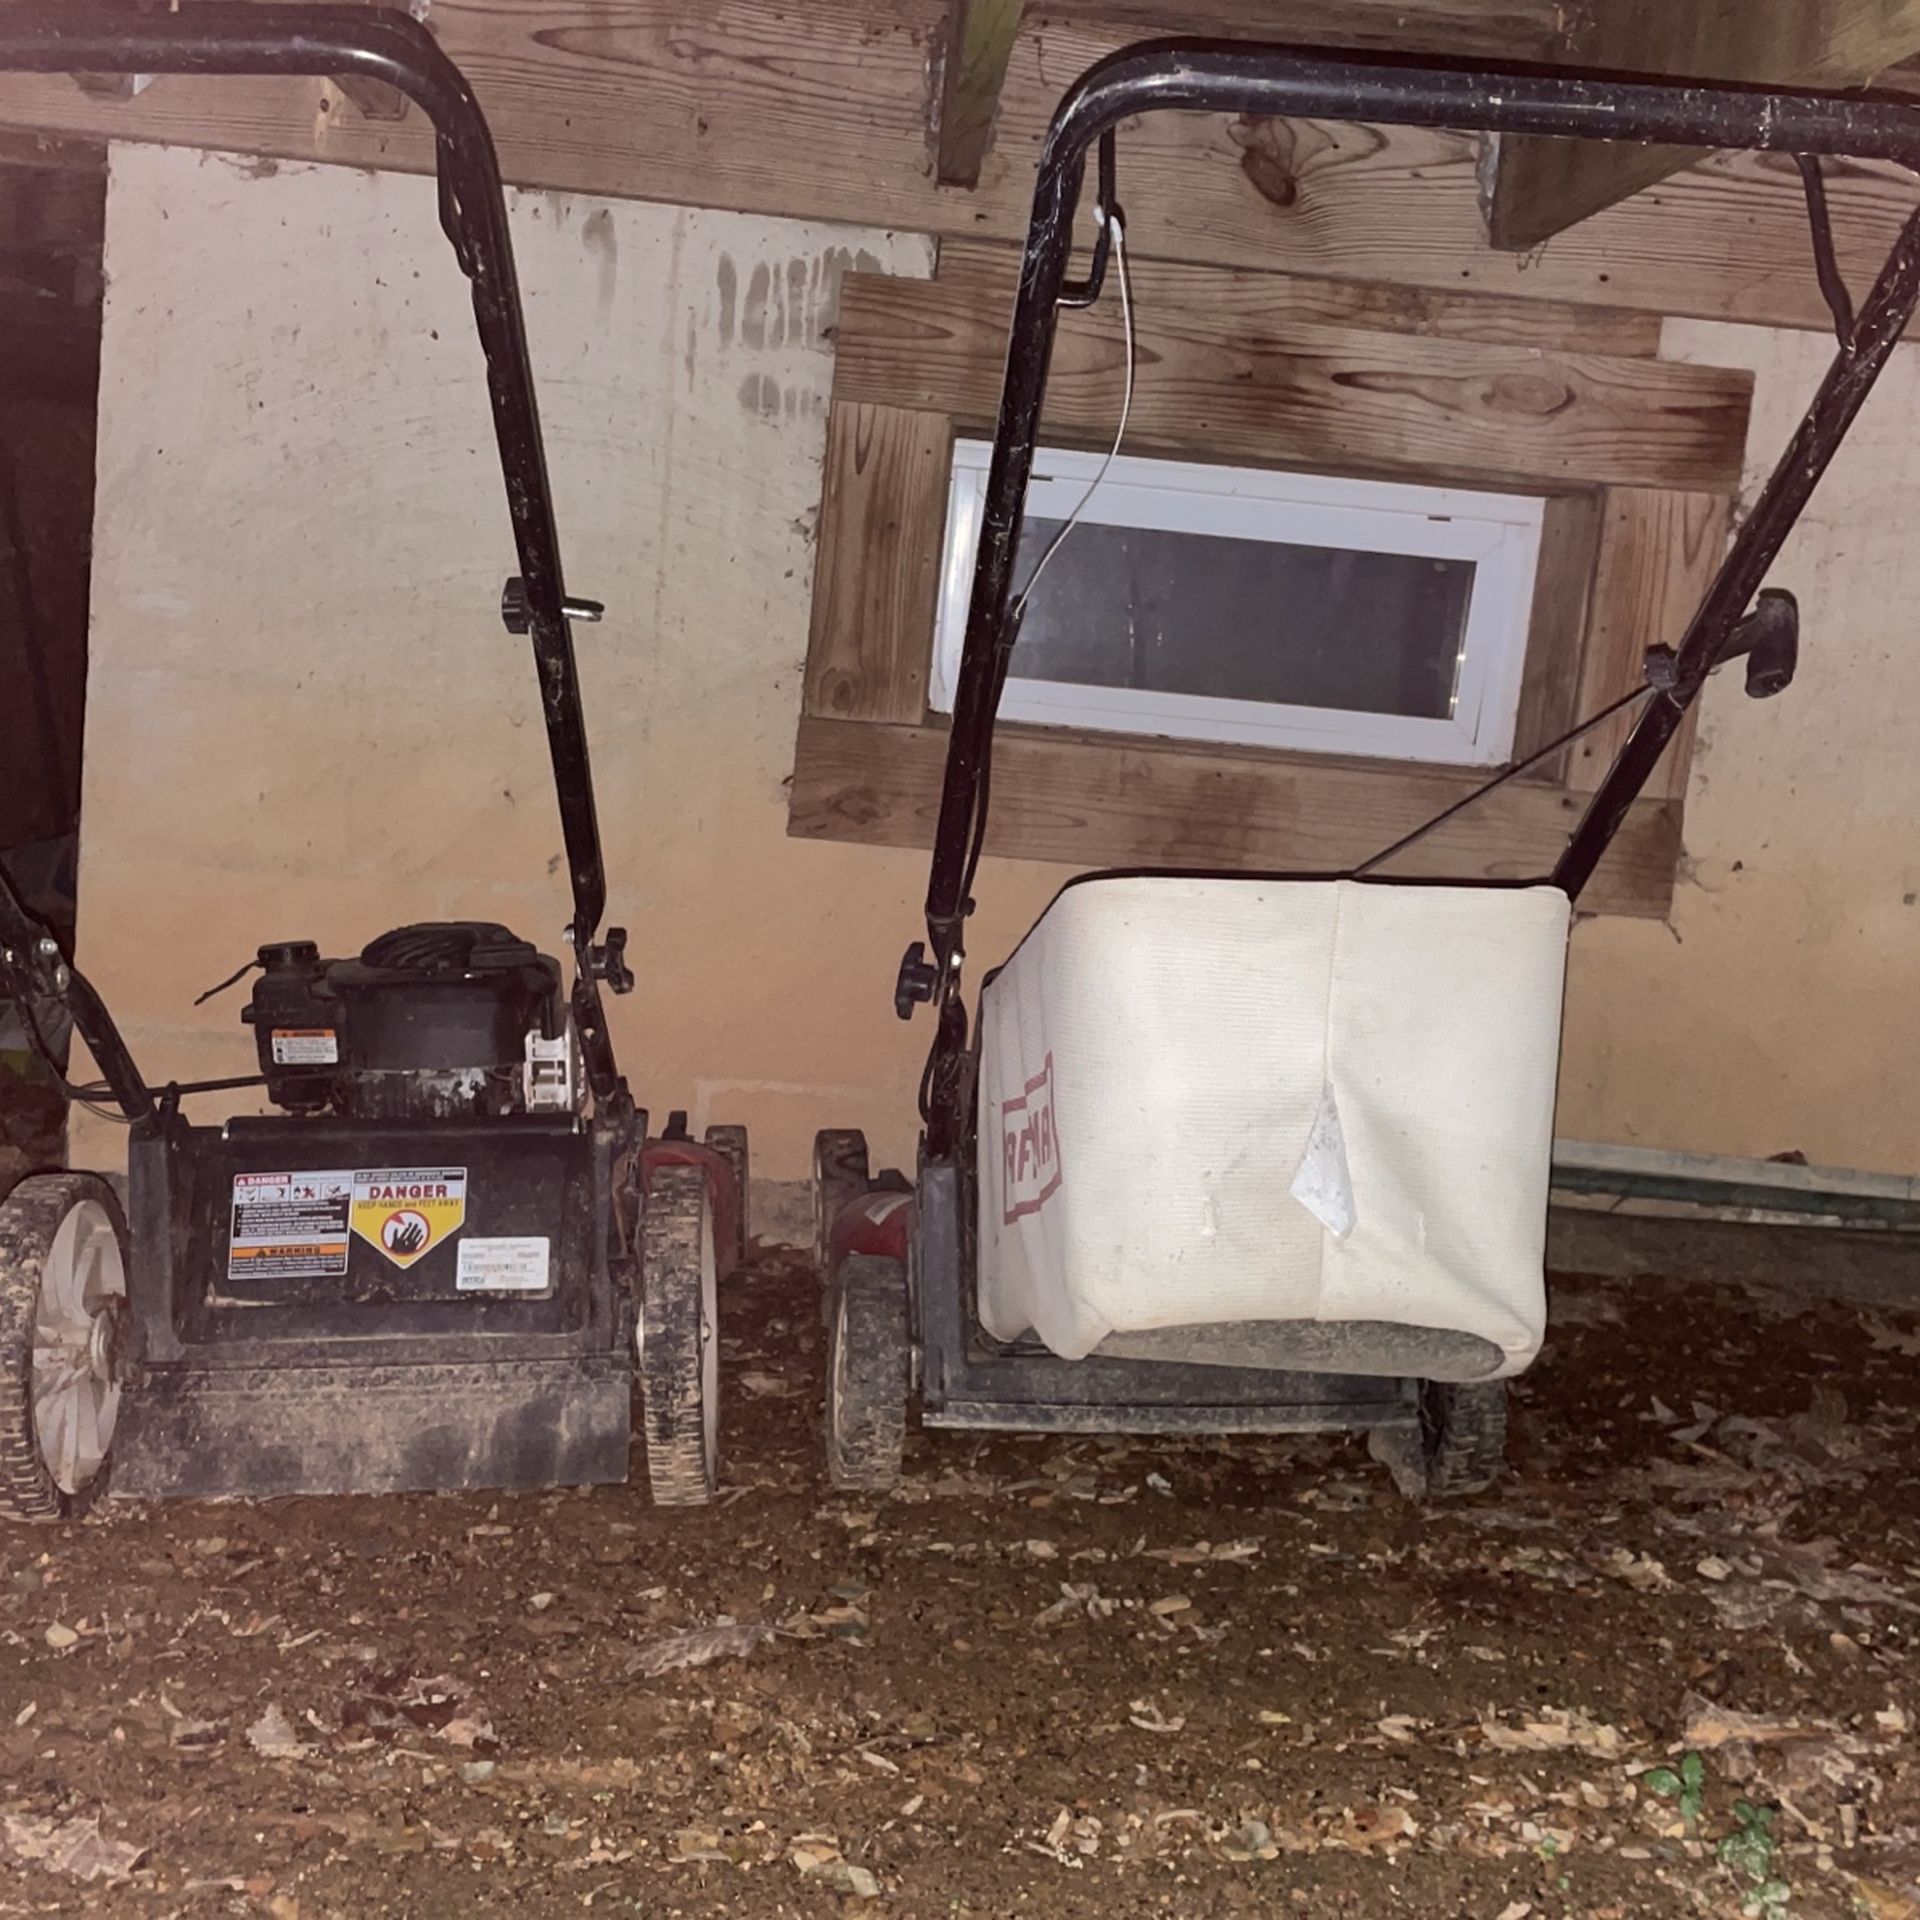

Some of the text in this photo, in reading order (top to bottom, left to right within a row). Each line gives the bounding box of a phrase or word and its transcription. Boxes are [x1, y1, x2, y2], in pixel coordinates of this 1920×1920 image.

[247, 1175, 289, 1185] DANGER
[369, 1184, 448, 1199] DANGER
[358, 1200, 376, 1209] KEEP
[378, 1200, 402, 1208] HANDS
[418, 1199, 436, 1208] FEET
[438, 1199, 459, 1207] AWAY
[269, 1246, 321, 1257] WARNING
